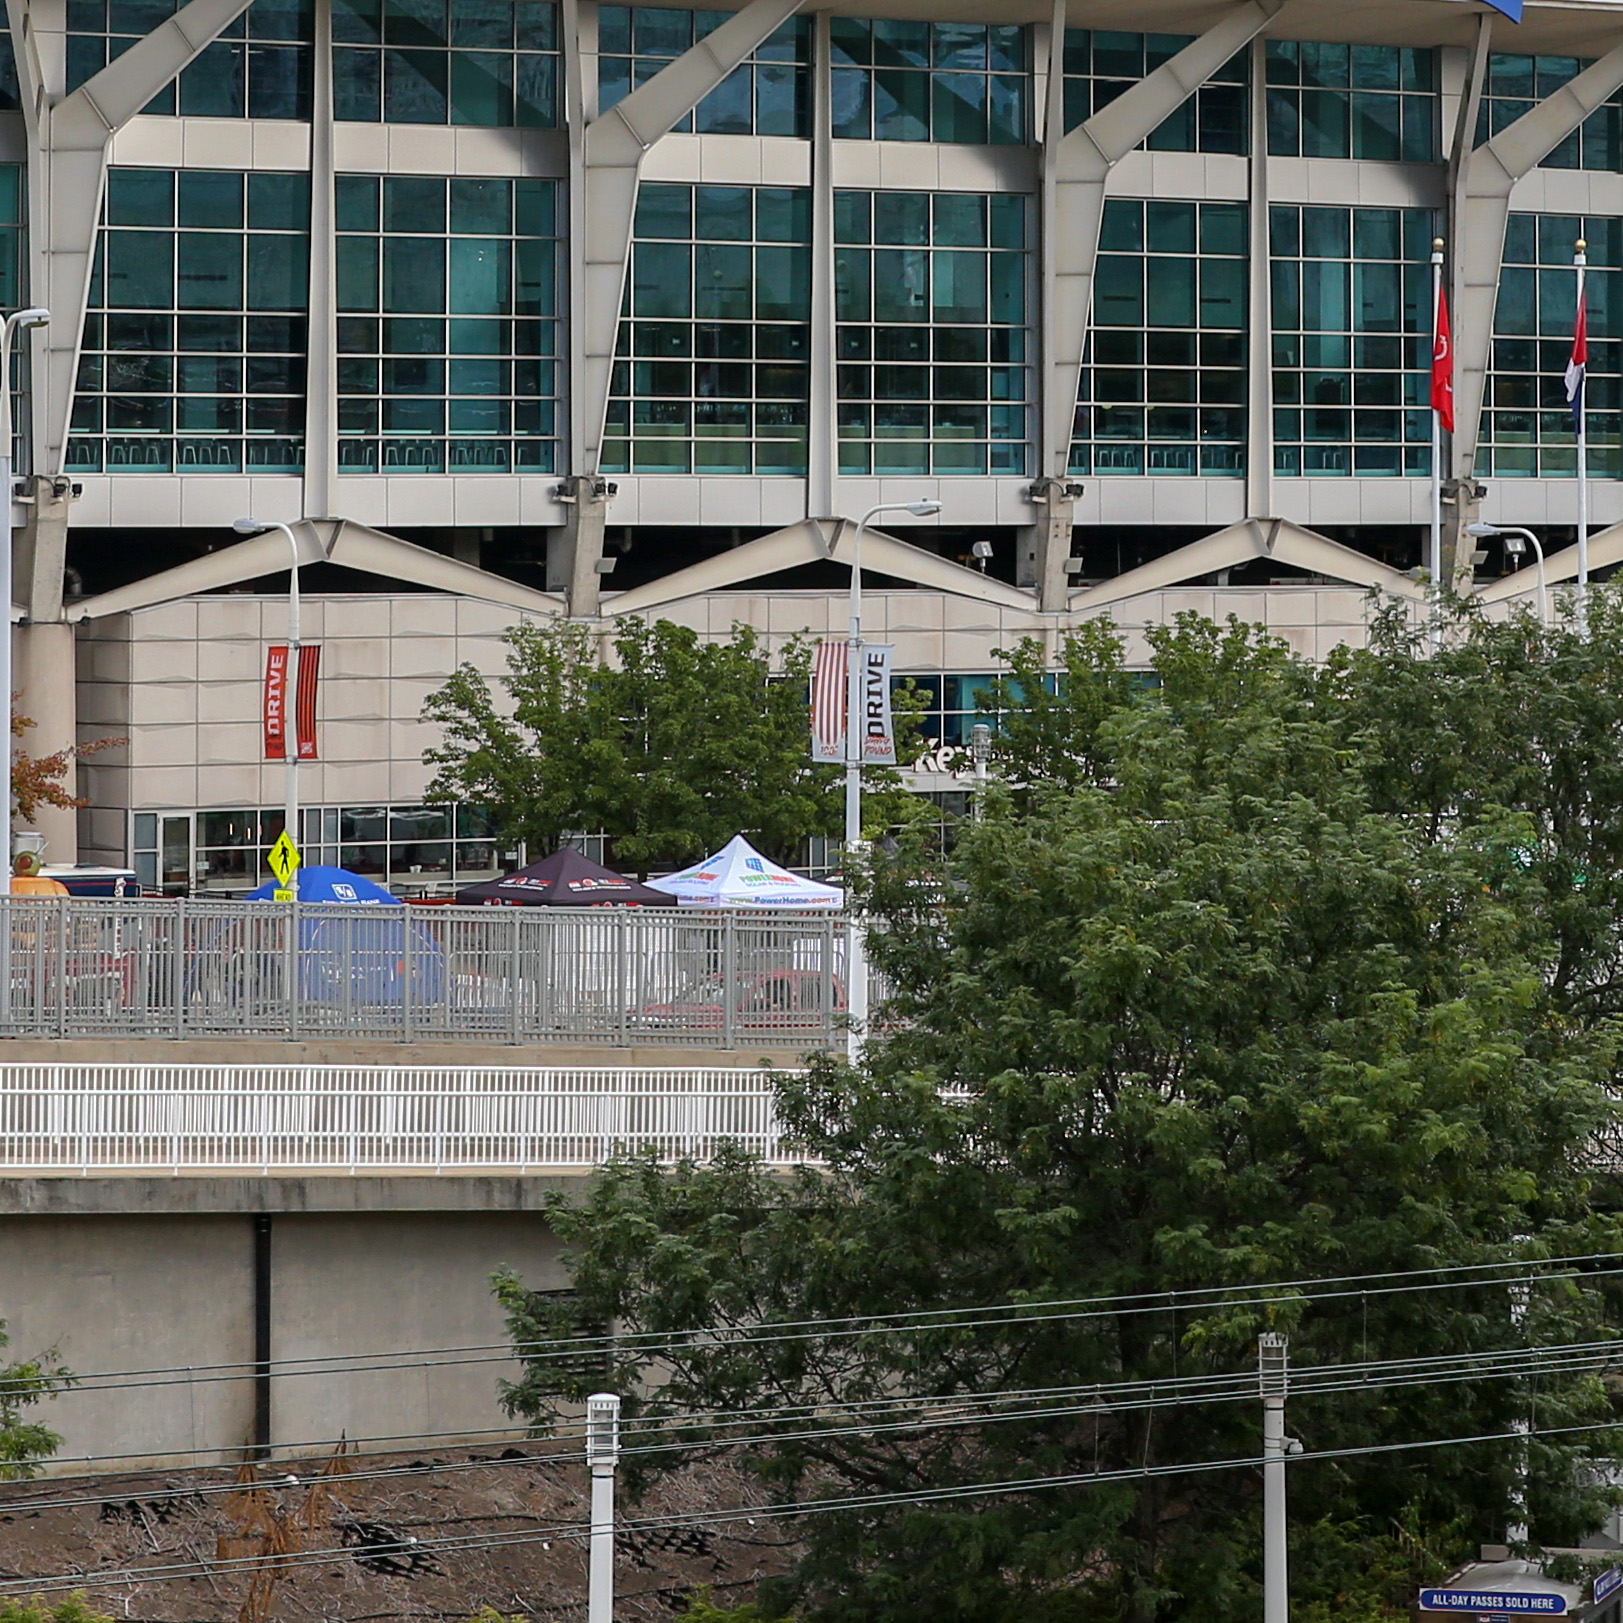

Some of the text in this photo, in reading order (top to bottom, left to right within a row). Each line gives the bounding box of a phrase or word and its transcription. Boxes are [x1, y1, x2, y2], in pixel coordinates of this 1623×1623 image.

[267, 654, 284, 736] DRIVE
[867, 653, 885, 737] DRIVE
[1432, 1594, 1554, 1610] ALL-DAY PASSES SOLD HERE
